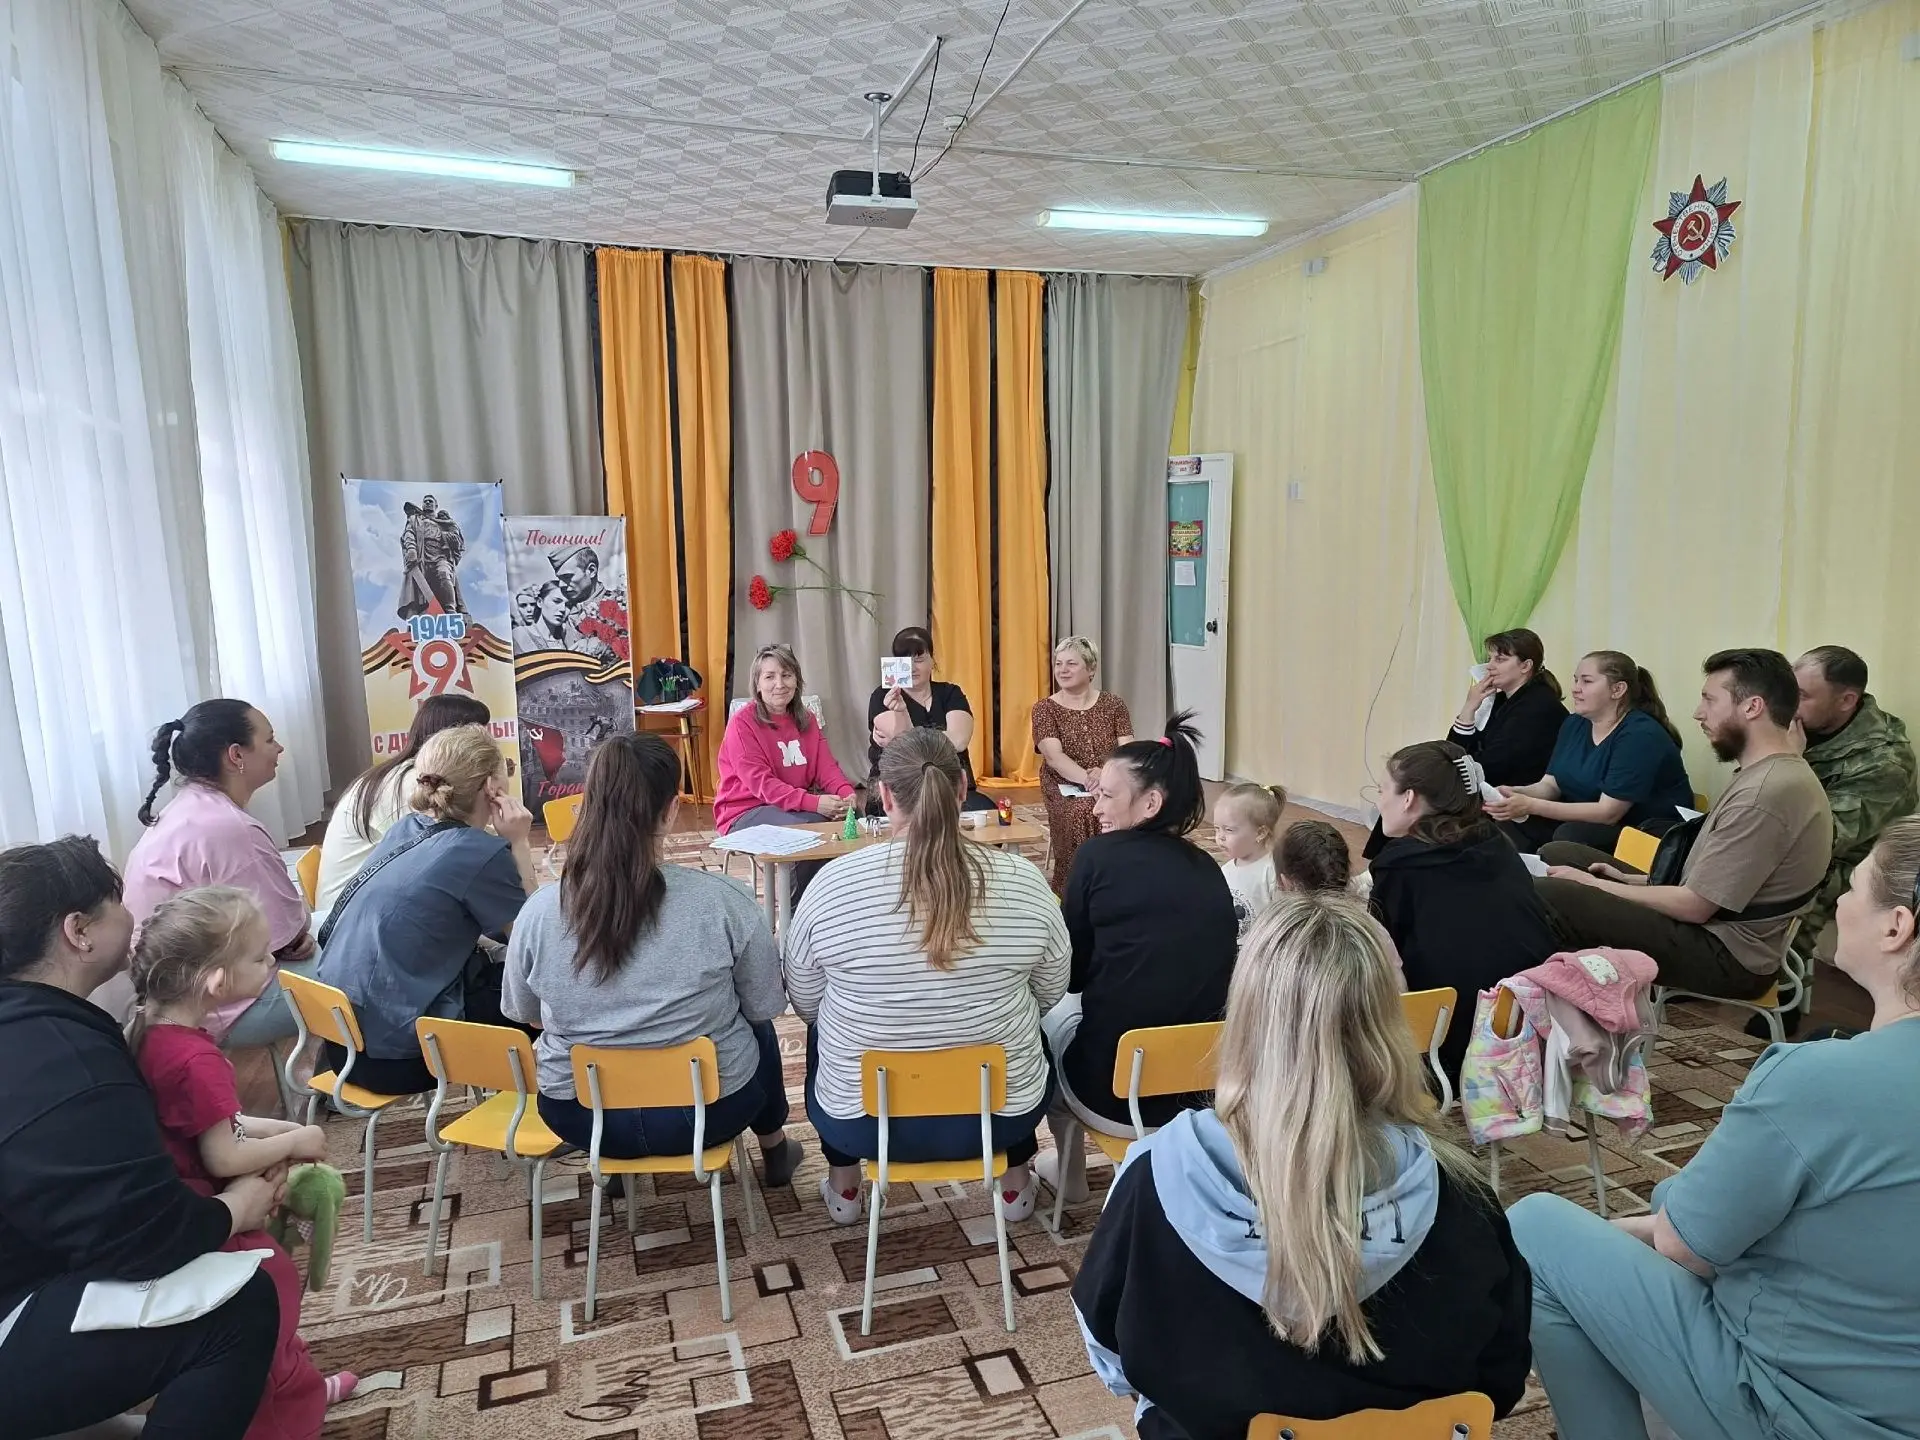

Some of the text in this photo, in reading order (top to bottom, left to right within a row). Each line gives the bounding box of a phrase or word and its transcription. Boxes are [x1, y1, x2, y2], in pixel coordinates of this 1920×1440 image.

[792, 449, 839, 536] 9
[525, 528, 606, 546] Помним!
[407, 614, 465, 642] 1945
[417, 639, 460, 697] 9
